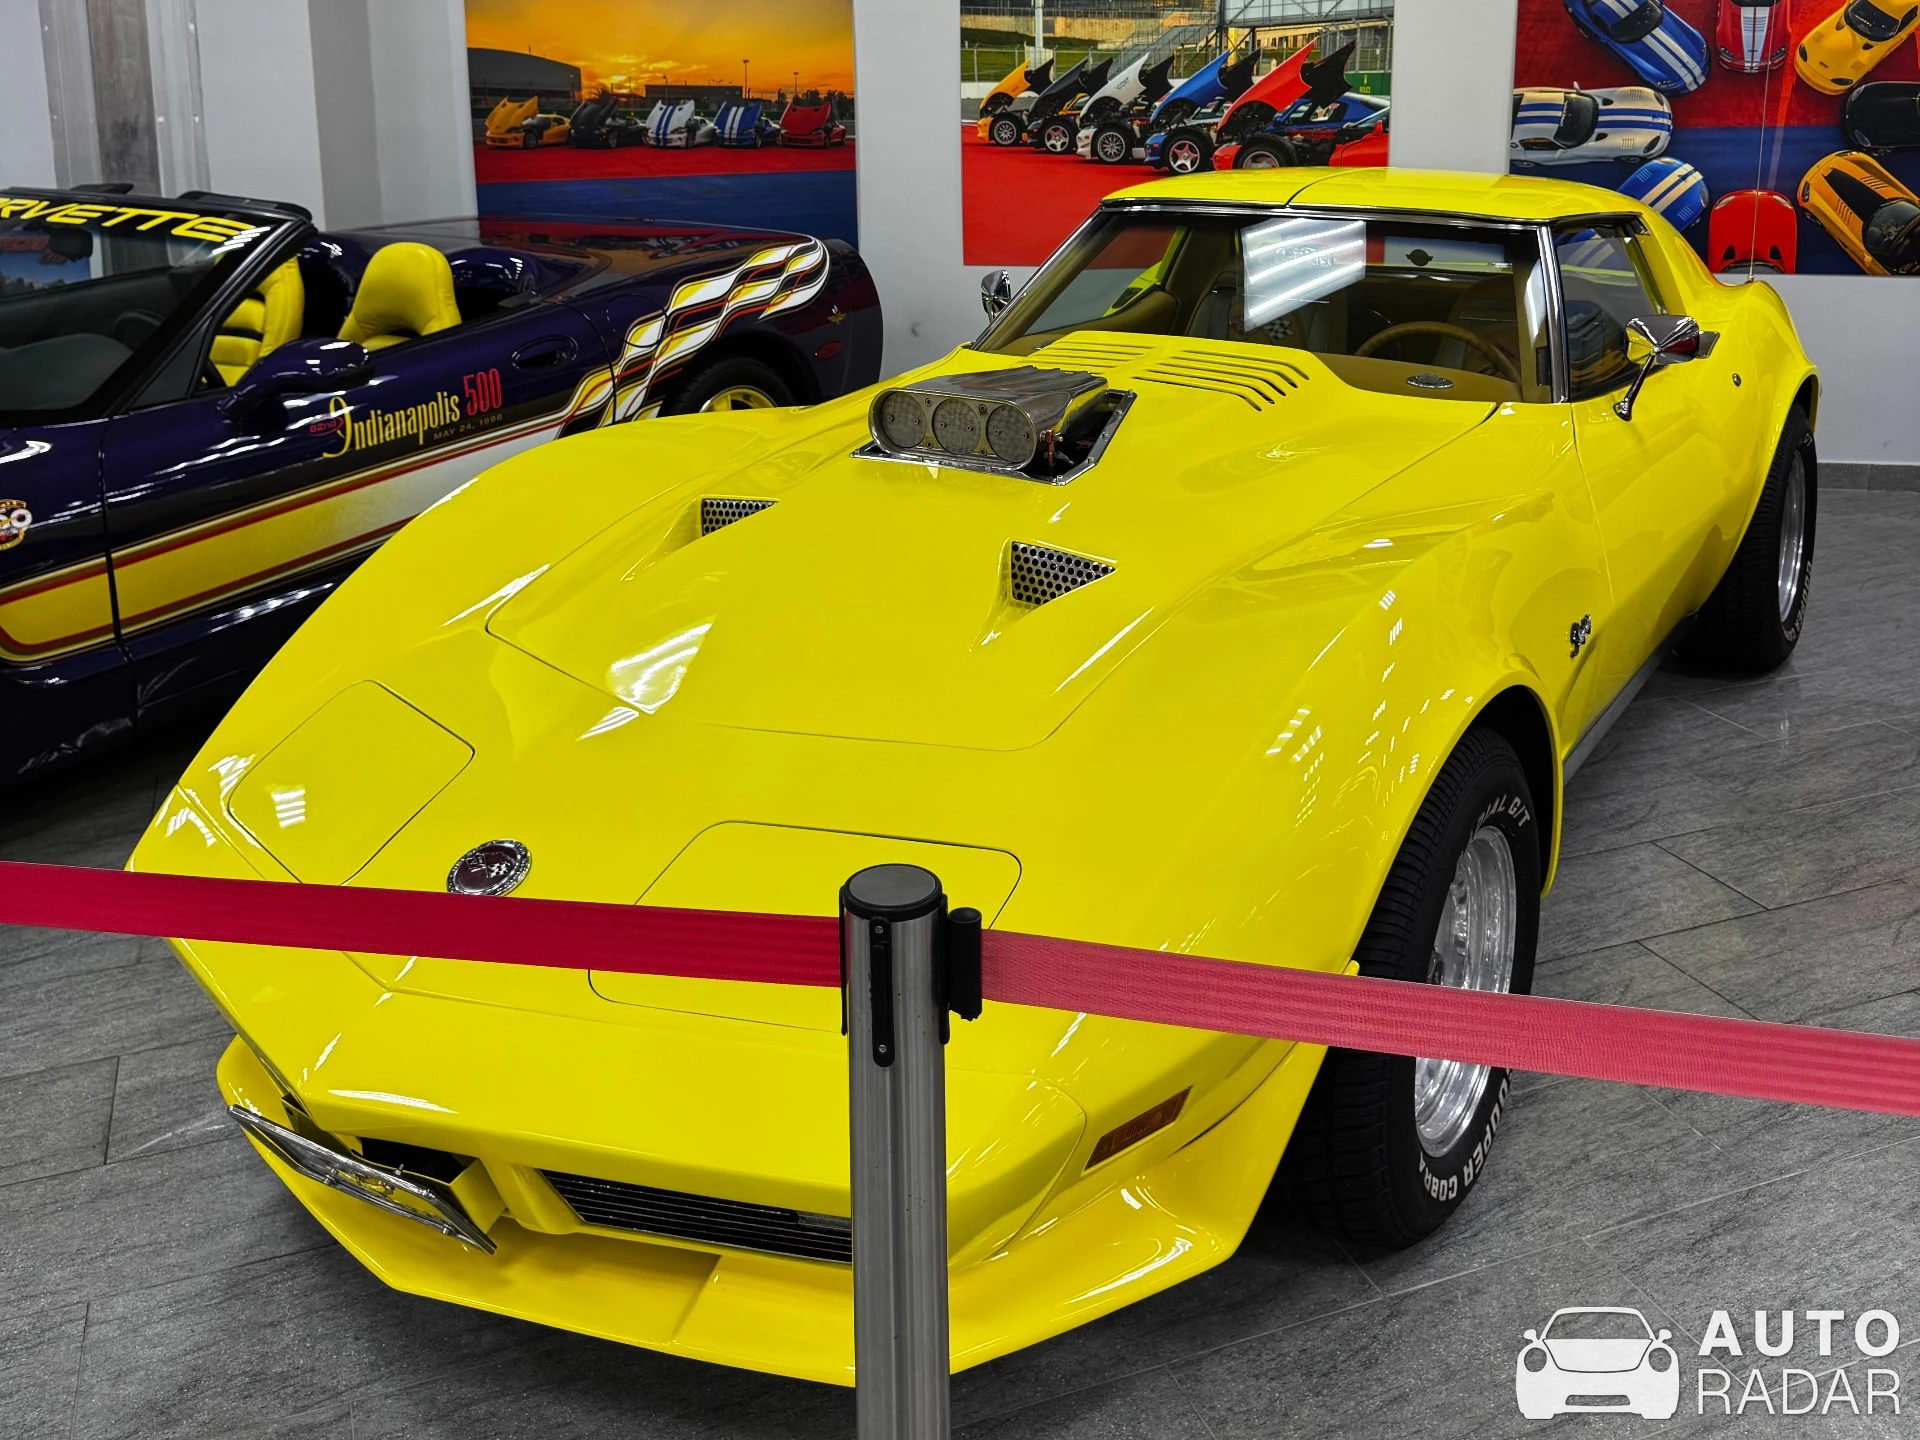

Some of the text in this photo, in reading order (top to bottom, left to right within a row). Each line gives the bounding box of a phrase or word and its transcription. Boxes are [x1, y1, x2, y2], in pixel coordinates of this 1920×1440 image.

[322, 391, 460, 459] Indianapolis
[462, 367, 503, 417] 500
[433, 427, 456, 440] MAY
[479, 413, 503, 426] 1998
[1507, 796, 1531, 827] G/T
[1419, 1068, 1511, 1201] OOPER COBRA
